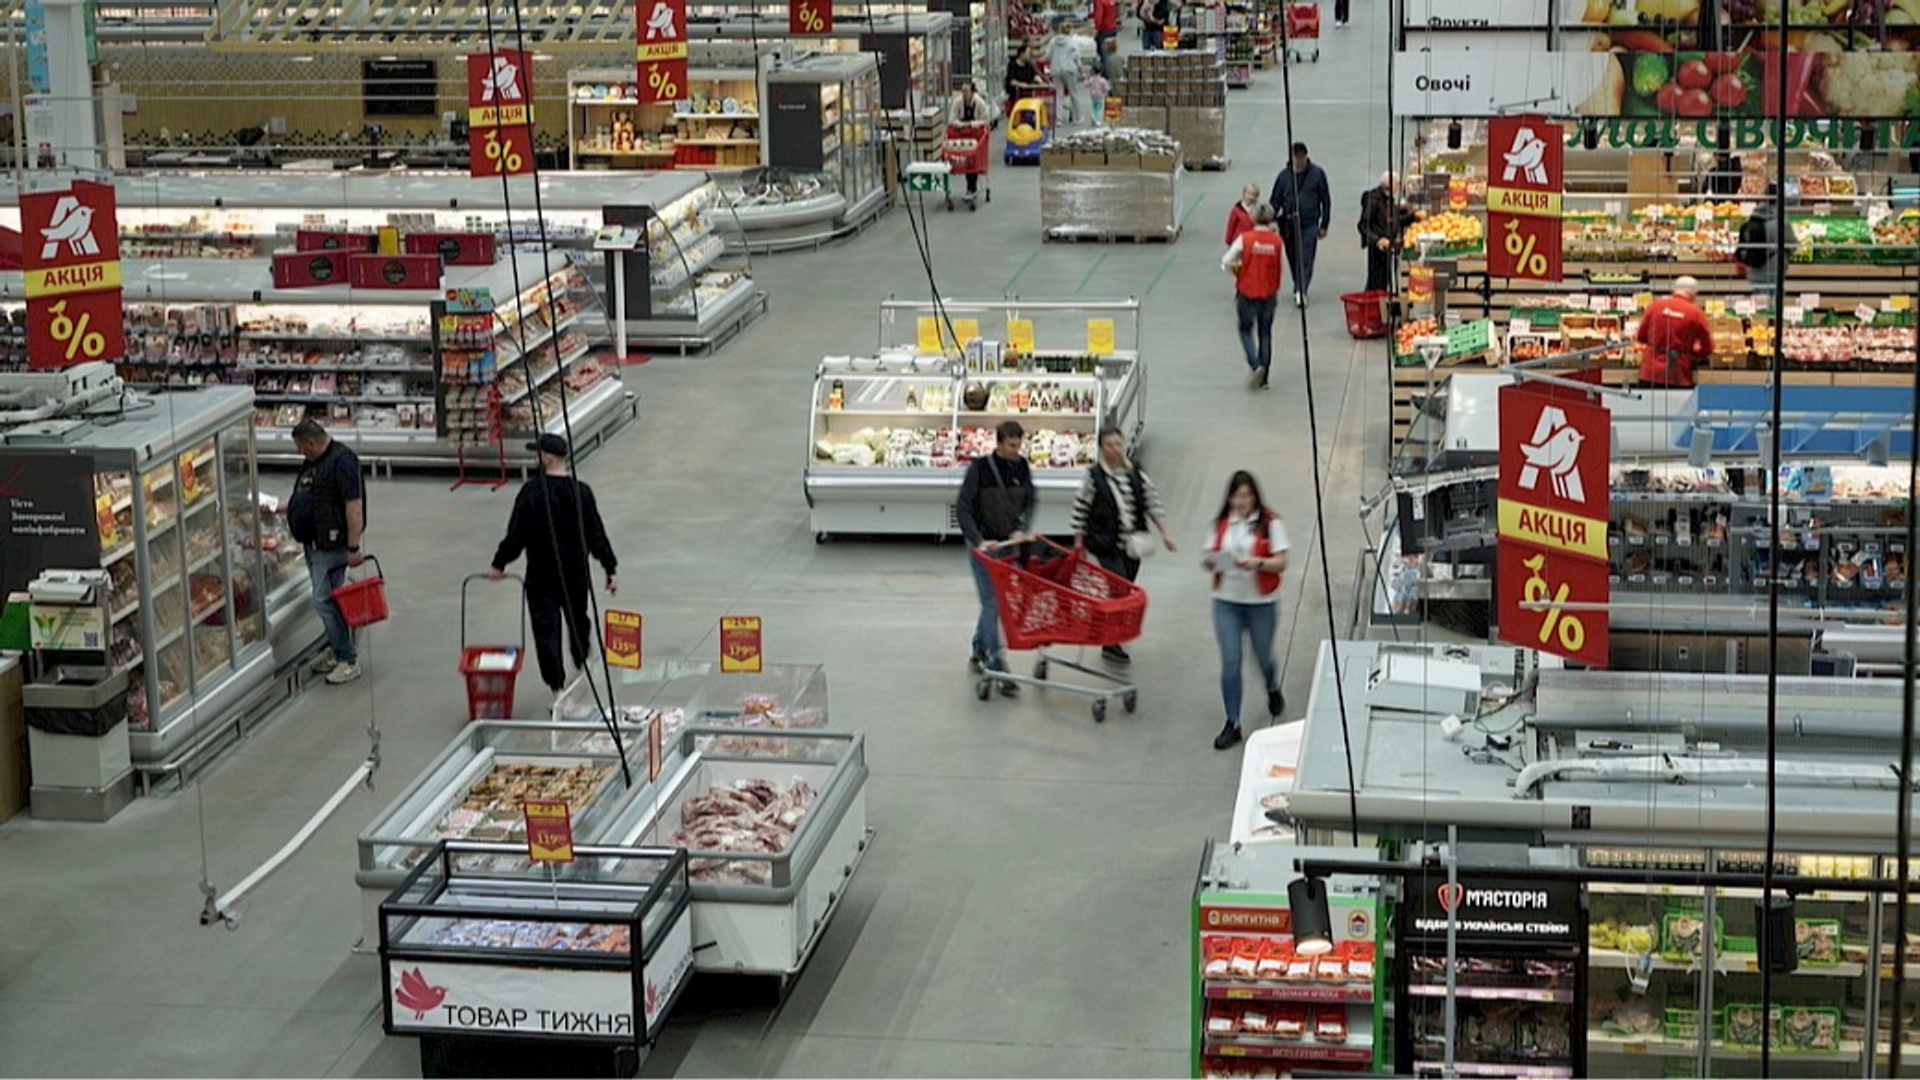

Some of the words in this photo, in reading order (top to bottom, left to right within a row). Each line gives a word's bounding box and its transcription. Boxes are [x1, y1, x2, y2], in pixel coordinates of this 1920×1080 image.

[646, 44, 679, 57] АКЦІЯ
[1415, 74, 1470, 91] Овочі
[1501, 191, 1549, 211] АКЦІЯ
[44, 265, 104, 287] АКЦІЯ
[1518, 508, 1587, 546] АКЦІЯ
[1466, 889, 1548, 909] М'ЯСТОРІЯ
[442, 1004, 528, 1028] ТОВАР
[536, 1009, 632, 1034] ТИЖНЯ
